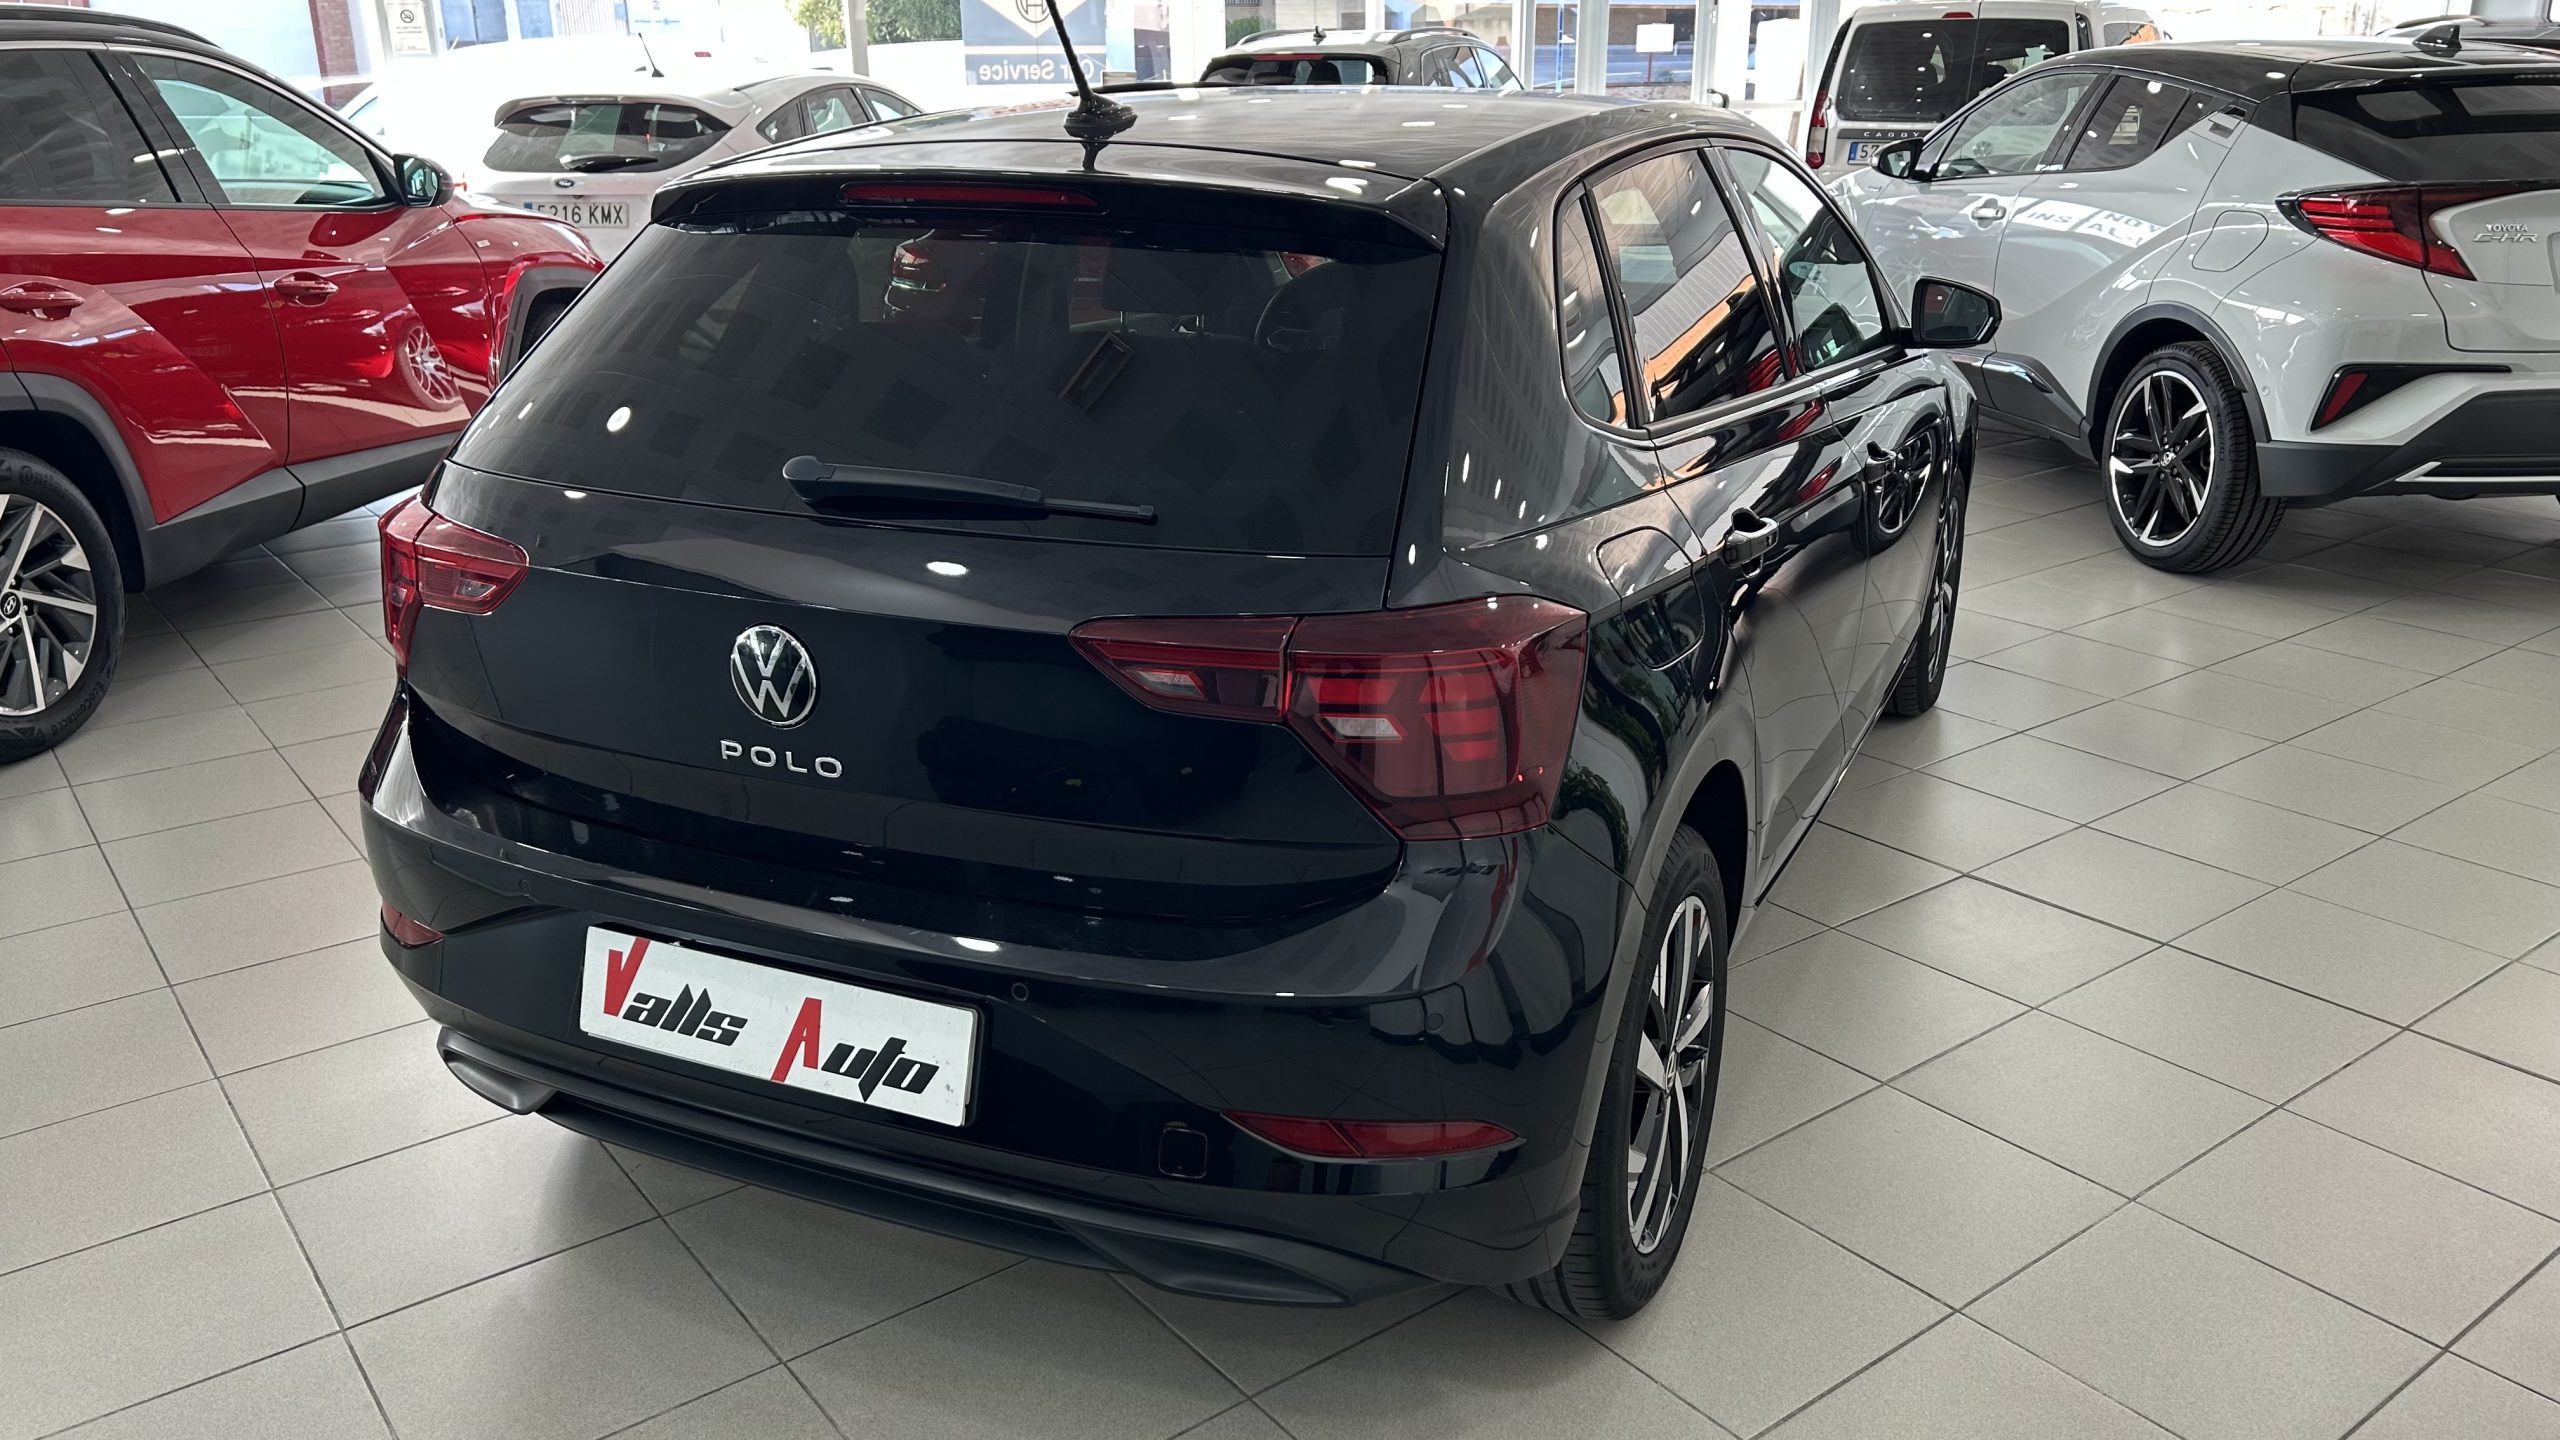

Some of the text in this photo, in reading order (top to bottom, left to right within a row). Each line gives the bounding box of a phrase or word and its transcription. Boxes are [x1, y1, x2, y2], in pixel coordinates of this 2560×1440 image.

[589, 204, 623, 225] KMX
[2472, 233, 2538, 242] C-HR
[2485, 223, 2529, 232] TOYOTA
[720, 739, 843, 779] POLO
[603, 936, 940, 1103] Valls Auto
